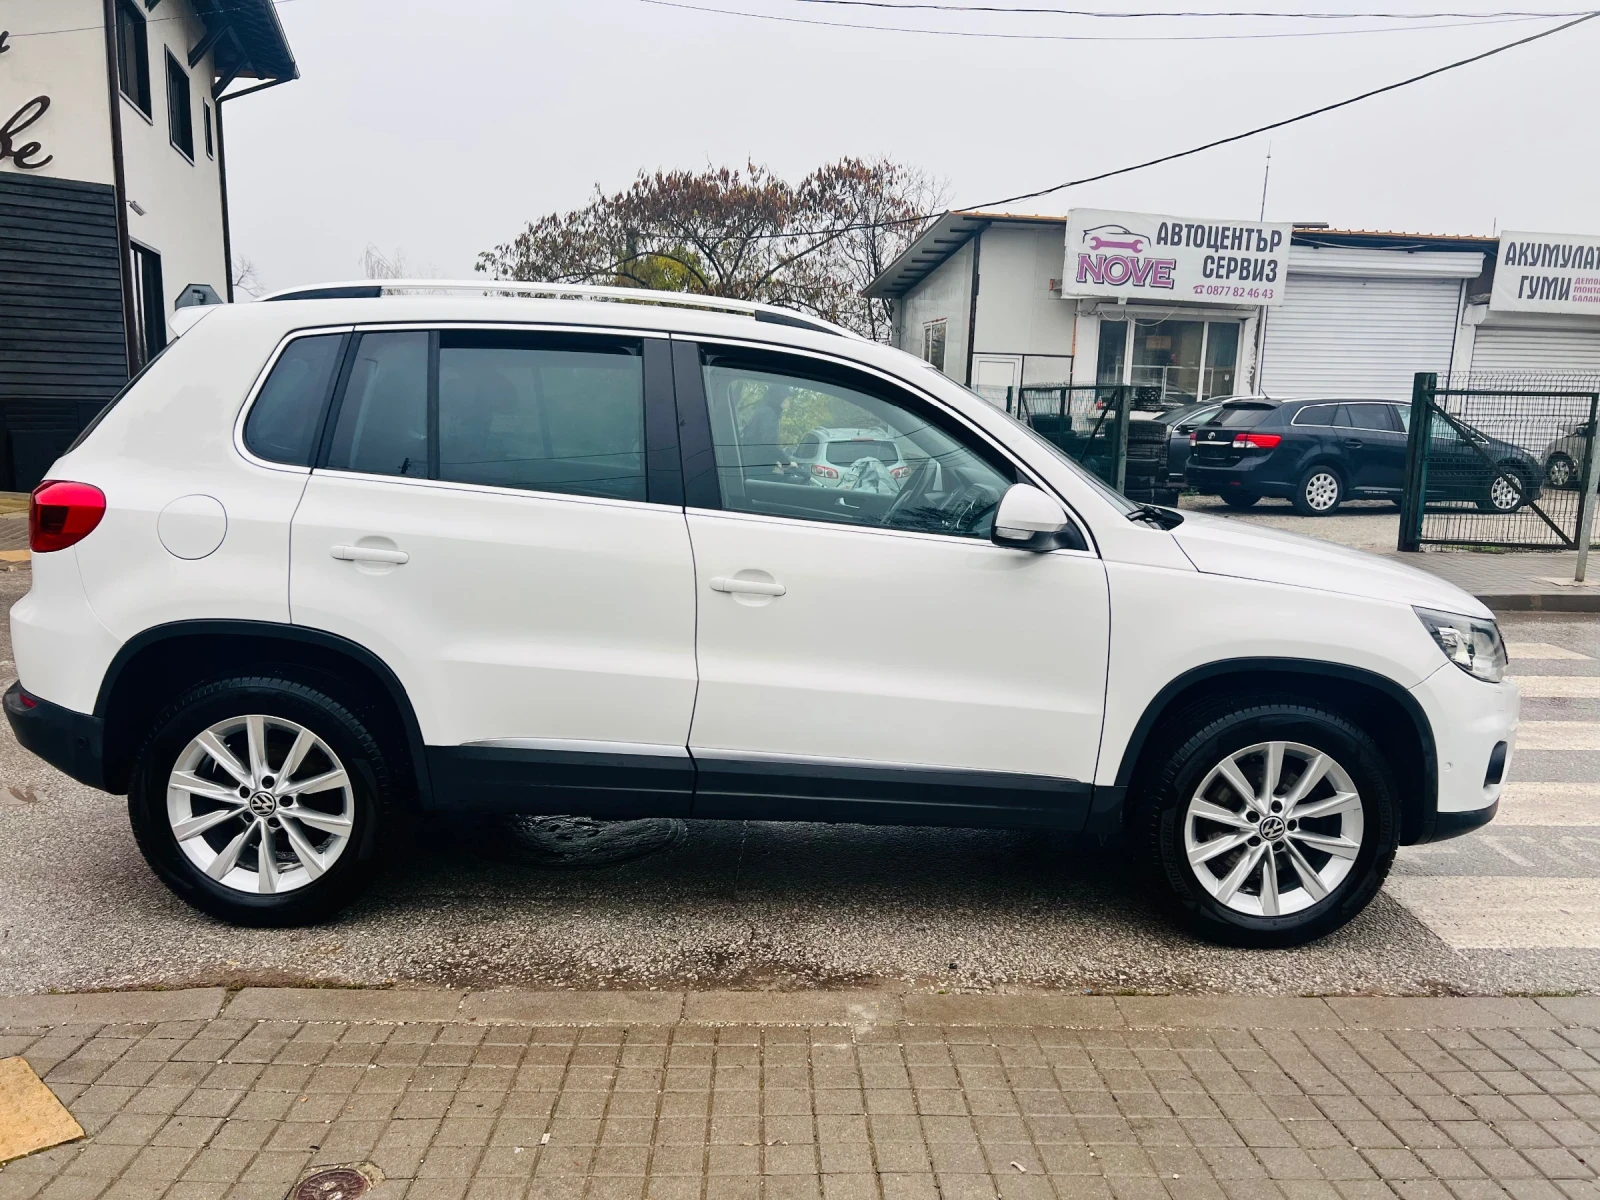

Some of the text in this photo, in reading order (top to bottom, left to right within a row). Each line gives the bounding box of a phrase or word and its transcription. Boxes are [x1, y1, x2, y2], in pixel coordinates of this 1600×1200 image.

[1157, 222, 1282, 253] АВТОЦЕНТЪР
[1076, 253, 1177, 290] NOVE
[1203, 255, 1278, 283] СЕРВИЗ
[1575, 277, 1600, 285] ДЕМО
[1207, 285, 1274, 299] 0877 82 46 43
[1518, 275, 1572, 301] ГУМИ
[1572, 296, 1600, 304] БАЛАН
